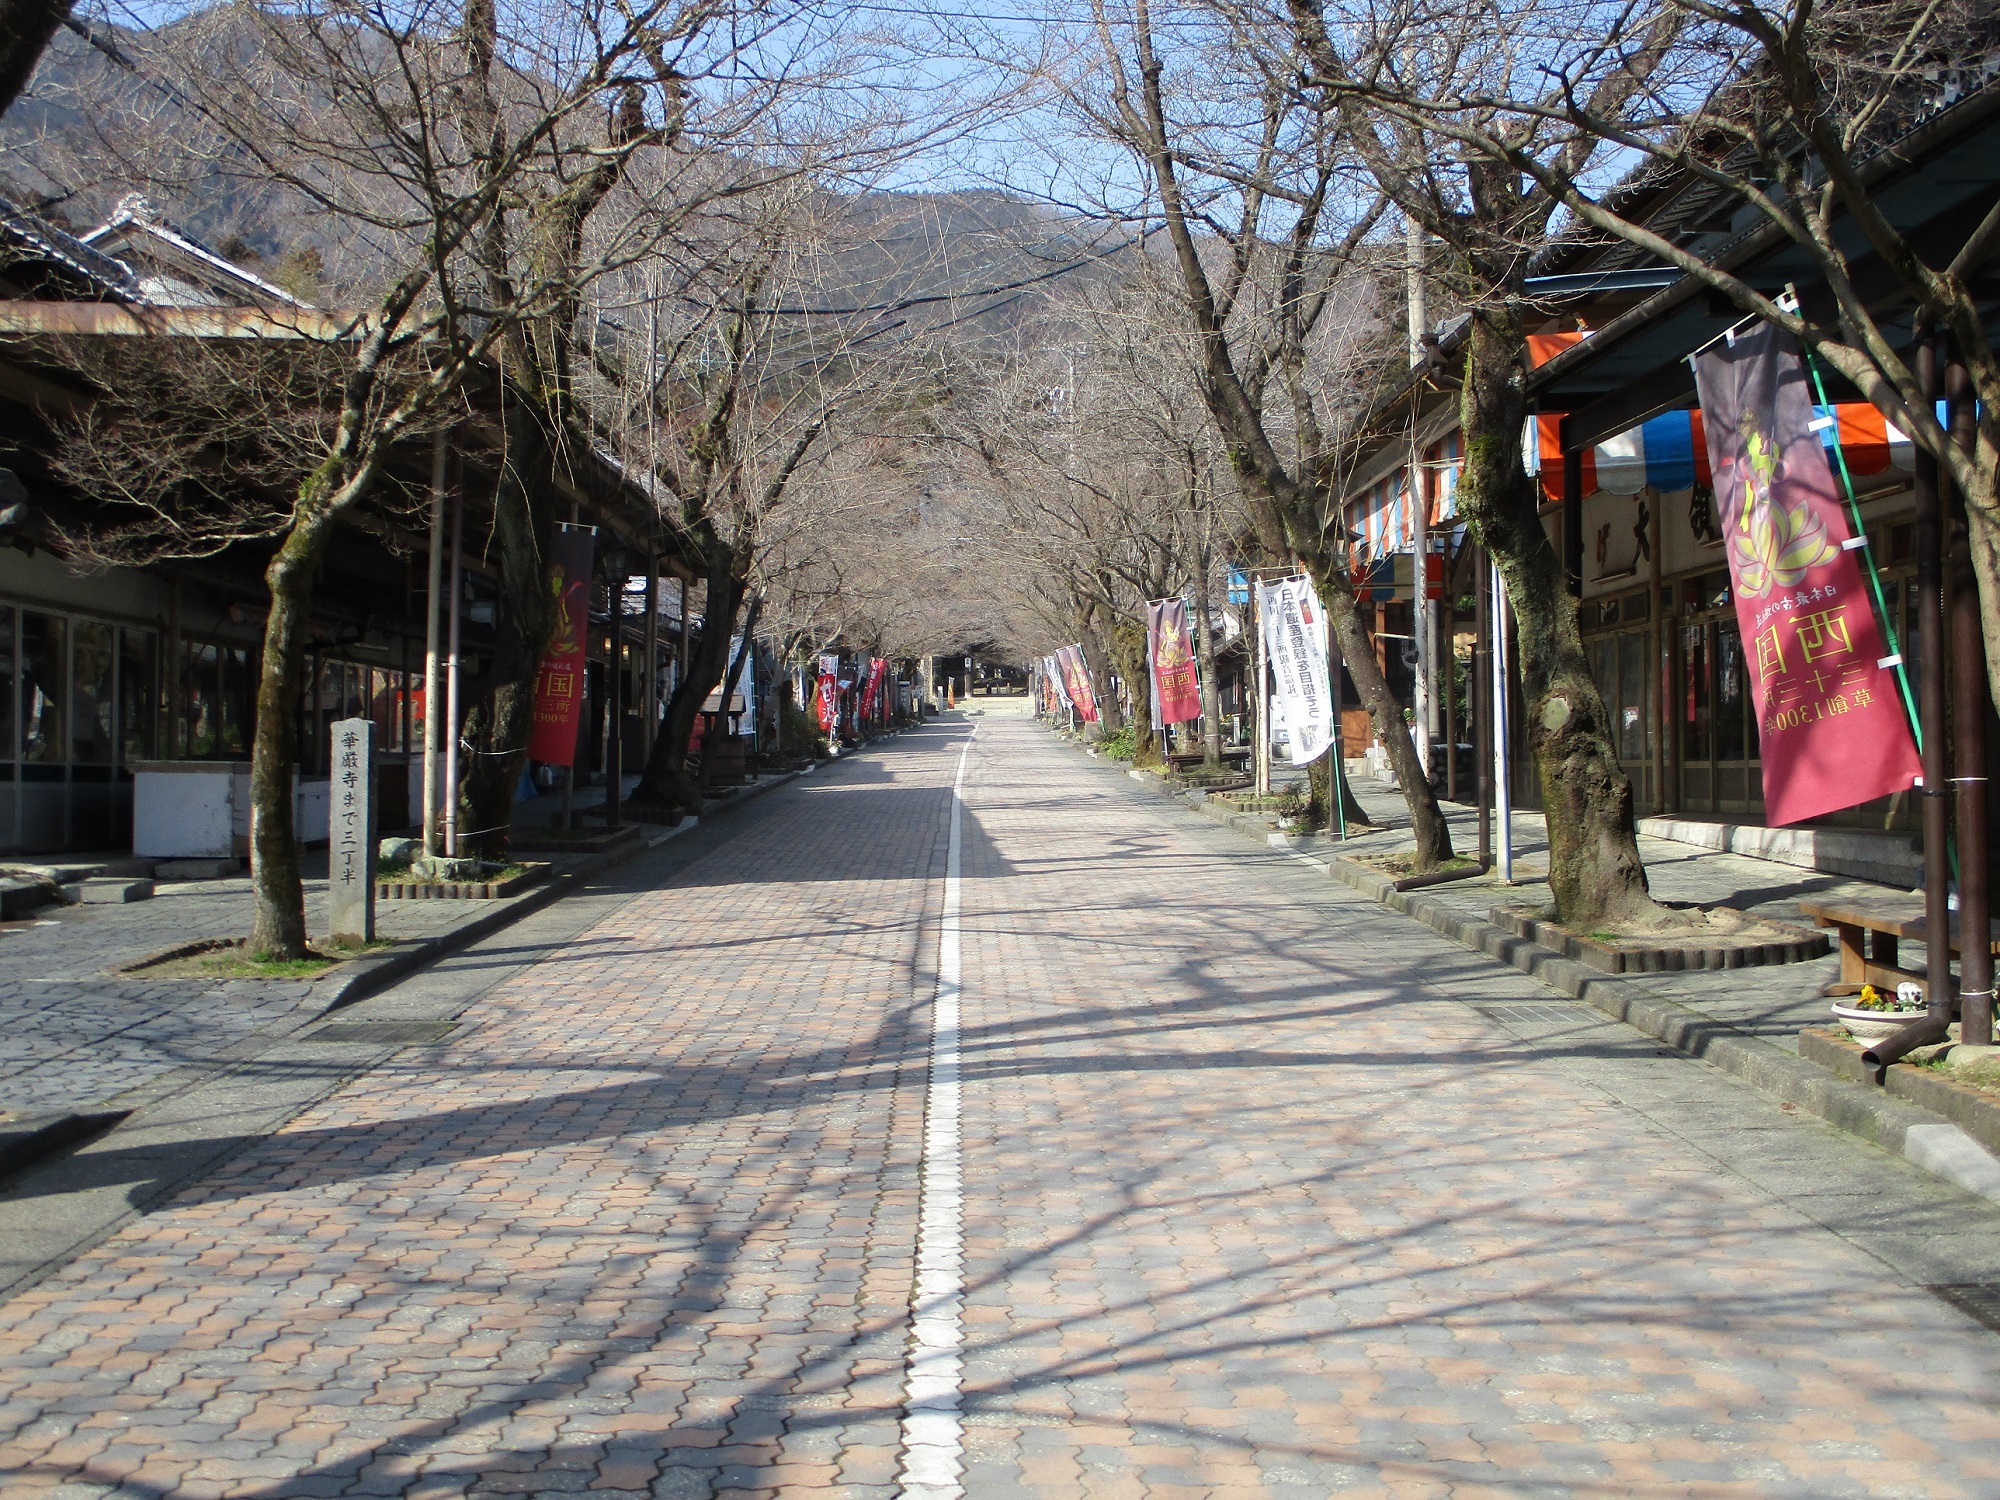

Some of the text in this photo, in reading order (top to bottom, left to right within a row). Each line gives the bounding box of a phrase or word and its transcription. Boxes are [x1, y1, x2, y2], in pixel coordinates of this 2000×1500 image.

[340, 731, 360, 886] 華厳寺まで三丁半
